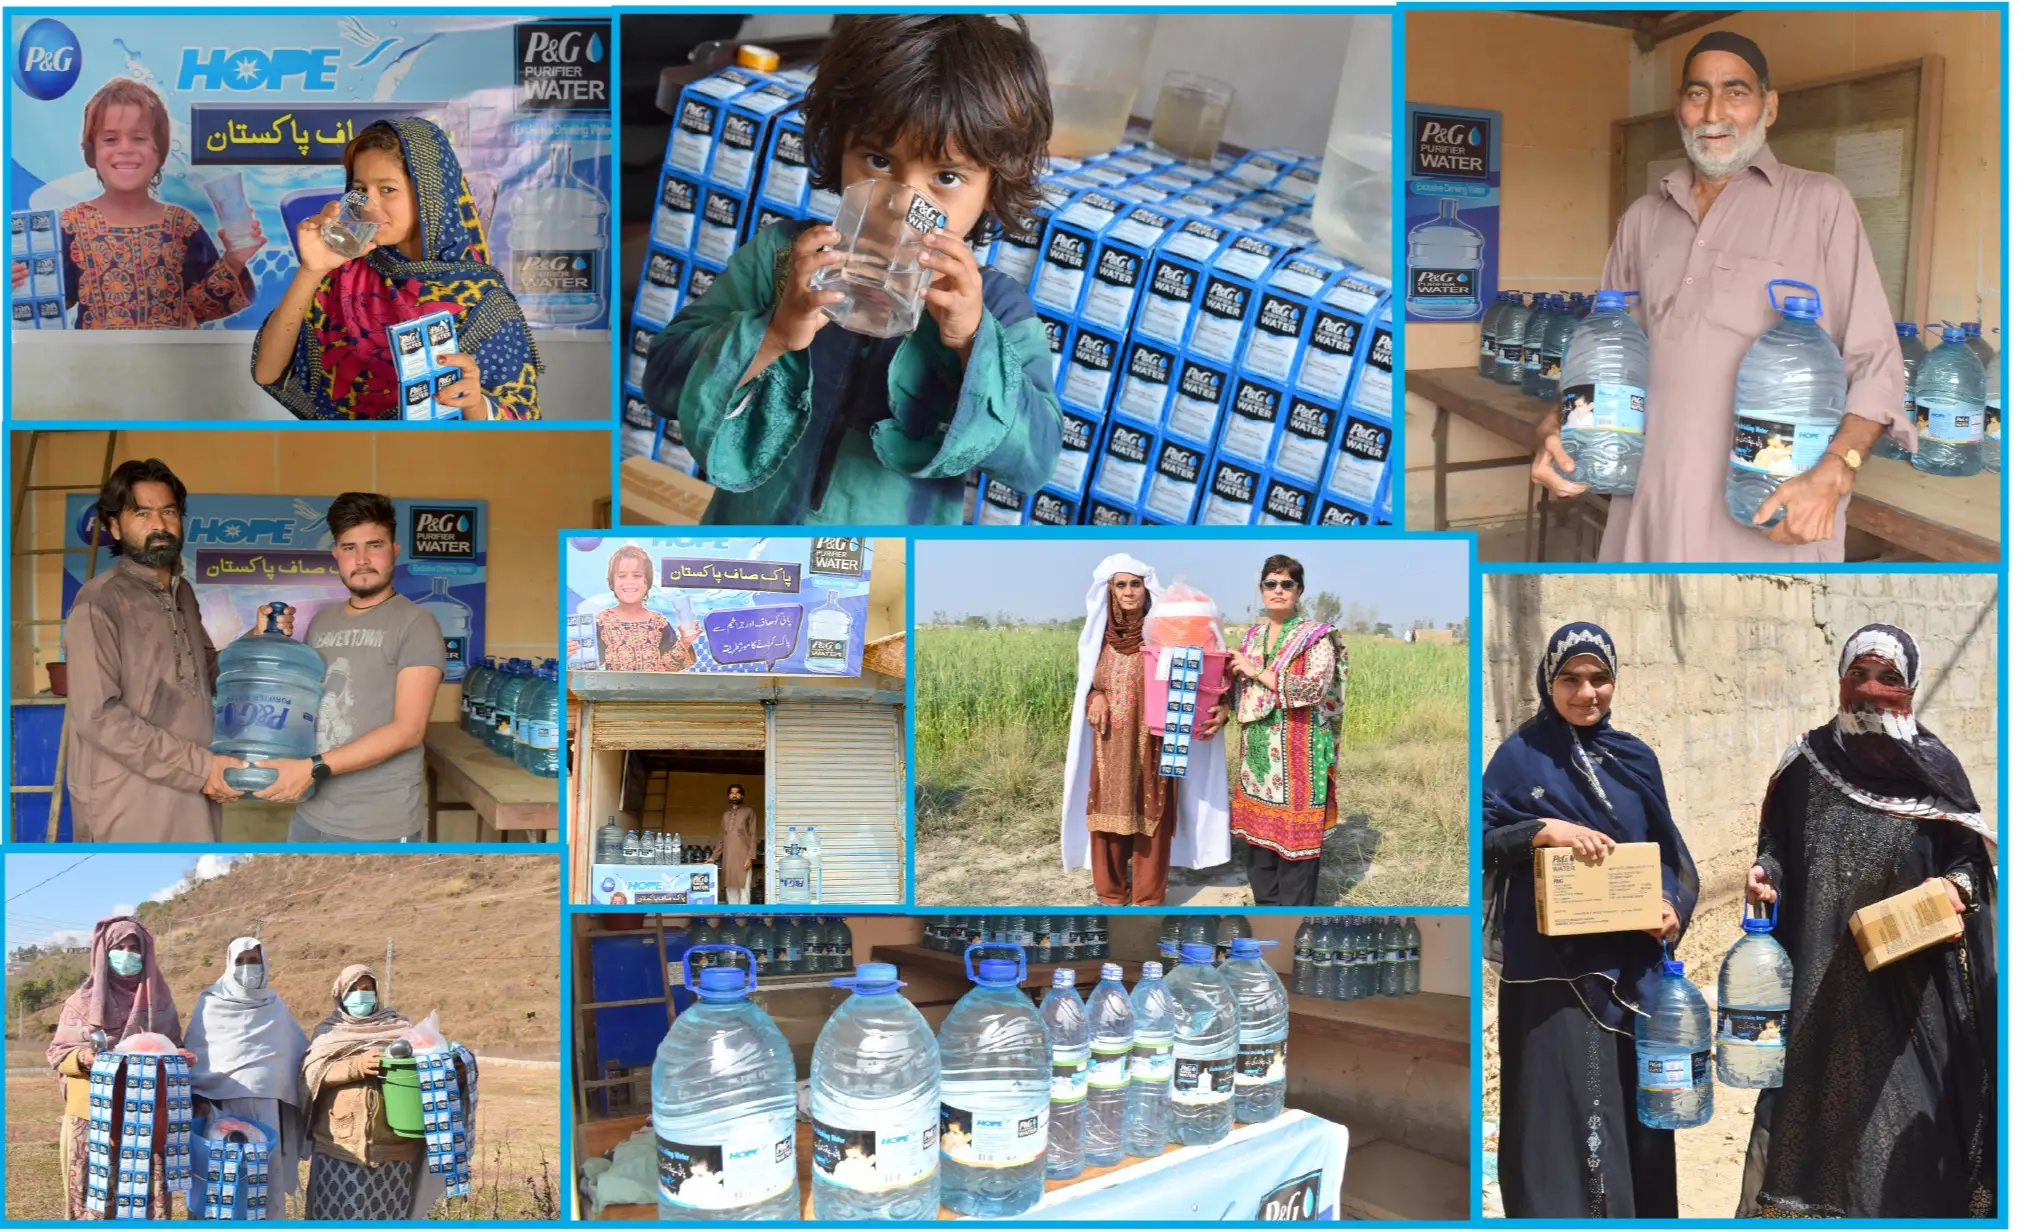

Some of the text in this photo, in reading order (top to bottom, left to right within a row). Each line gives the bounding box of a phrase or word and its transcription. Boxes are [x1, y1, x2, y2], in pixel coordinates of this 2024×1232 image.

[524, 31, 582, 63] P&G
[24, 44, 73, 72] P&G
[176, 46, 341, 92] HOPE
[525, 66, 582, 77] PURIFIER
[523, 80, 606, 100] WATER
[206, 113, 352, 156] اف پاکستان
[1420, 121, 1466, 145] P&G
[1420, 144, 1466, 155] PURIFIER
[1420, 153, 1483, 171] WATER
[912, 197, 936, 221] P&G
[909, 213, 930, 234] WAT
[1054, 233, 1080, 251] P&G
[522, 256, 569, 271] P&G
[1050, 249, 1084, 268] WATER
[1104, 250, 1130, 268] P&G
[1099, 266, 1134, 285] WATER
[1159, 264, 1184, 281] P&G
[1417, 271, 1454, 282] P&G
[521, 278, 588, 288] WATER
[1154, 280, 1189, 299] WATER
[1210, 282, 1237, 300] P&G
[1418, 286, 1470, 294] WATER
[1206, 297, 1242, 317] WATER
[1265, 299, 1292, 317] P&G
[1261, 315, 1297, 335] WATER
[1318, 317, 1346, 334] P&G
[1078, 334, 1104, 351] P&G
[1314, 332, 1352, 352] WATER
[1376, 334, 1392, 351] P&
[1075, 350, 1109, 368] WATER
[1135, 347, 1160, 365] P&G
[1131, 364, 1166, 382] WATER
[1185, 366, 1212, 383] P&G
[1183, 382, 1217, 400] WATER
[1240, 385, 1267, 402] P&G
[1236, 401, 1272, 419] WATER
[1293, 403, 1321, 421] P&G
[1113, 427, 1140, 445] P&G
[1290, 418, 1326, 437] WATER
[1350, 422, 1378, 442] P&G
[1798, 431, 1820, 440] HOPE
[1063, 435, 1087, 449] ATER
[1346, 438, 1384, 458] WATER
[1111, 443, 1145, 461] WATER
[1163, 446, 1190, 463] P&G
[1160, 461, 1195, 480] WATER
[1219, 466, 1246, 485] P&G
[987, 491, 1019, 509] WATER
[1216, 482, 1251, 501] WATER
[1271, 485, 1299, 504] P&G
[1037, 495, 1061, 511] P&G
[1268, 501, 1303, 520] WATER
[417, 513, 455, 532] P&G
[1034, 509, 1068, 525] WATER
[1096, 506, 1119, 521] P&G
[1324, 507, 1353, 526] P&G
[187, 518, 297, 545] HOPE
[417, 533, 455, 541] PURIFIER
[416, 541, 471, 553] WATER
[816, 537, 847, 550] P&G
[206, 556, 276, 580] پاکستان
[278, 559, 325, 576] صاف
[816, 556, 858, 571] WATER
[670, 563, 792, 587] پاک صاف پاکستان
[811, 640, 834, 650] P&G
[241, 703, 290, 730] P&G
[1552, 855, 1569, 863] P&G
[627, 881, 663, 891] HOPE
[976, 1119, 1003, 1128] HOPE
[880, 1135, 910, 1145] HOPE
[729, 1148, 758, 1160] HOPE
